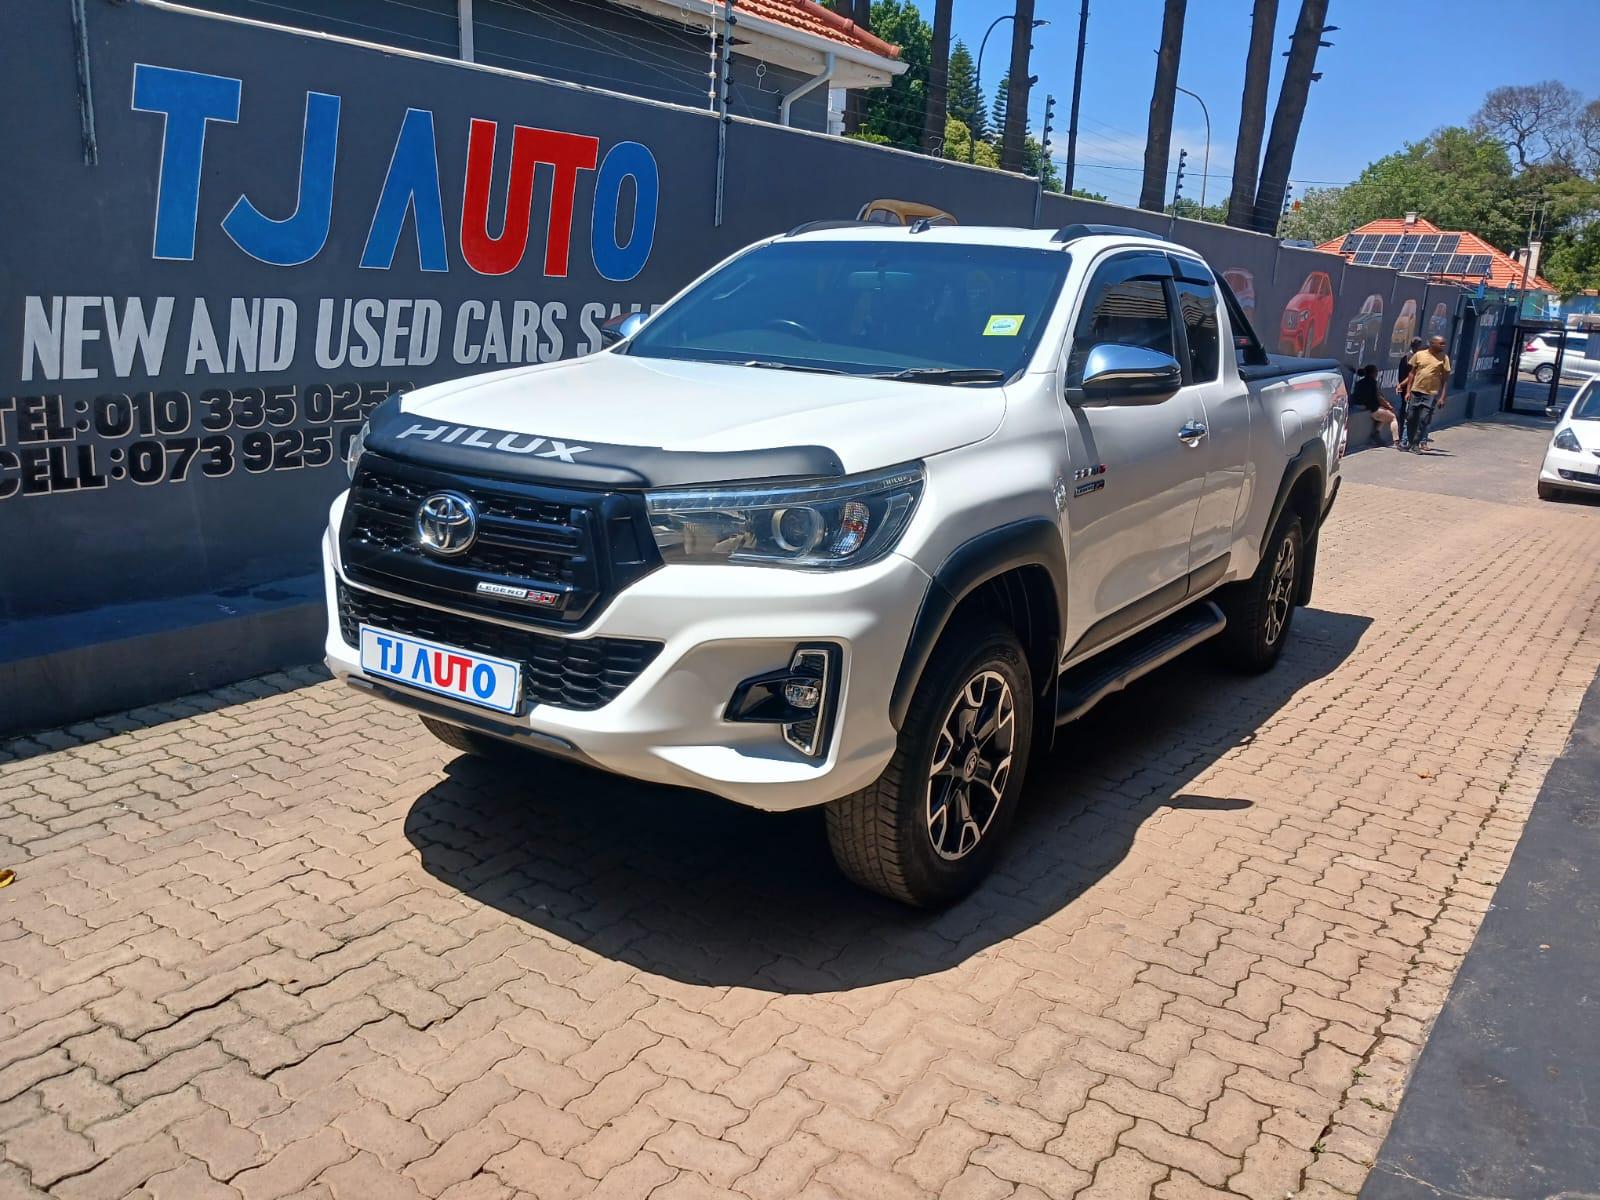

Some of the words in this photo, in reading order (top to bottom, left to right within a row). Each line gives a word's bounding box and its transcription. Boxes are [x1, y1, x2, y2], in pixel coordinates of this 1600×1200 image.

[131, 63, 341, 266] TJ
[358, 107, 659, 282] AUTO
[21, 295, 175, 381] NEW
[185, 297, 298, 375] AND
[314, 298, 439, 370] USED
[452, 300, 567, 365] CARS
[201, 384, 297, 432] 335
[242, 426, 333, 474] 925
[396, 424, 593, 463] HILUX
[478, 584, 525, 597] LEGEND
[377, 637, 403, 674] TJ
[412, 647, 497, 699] AUTO
